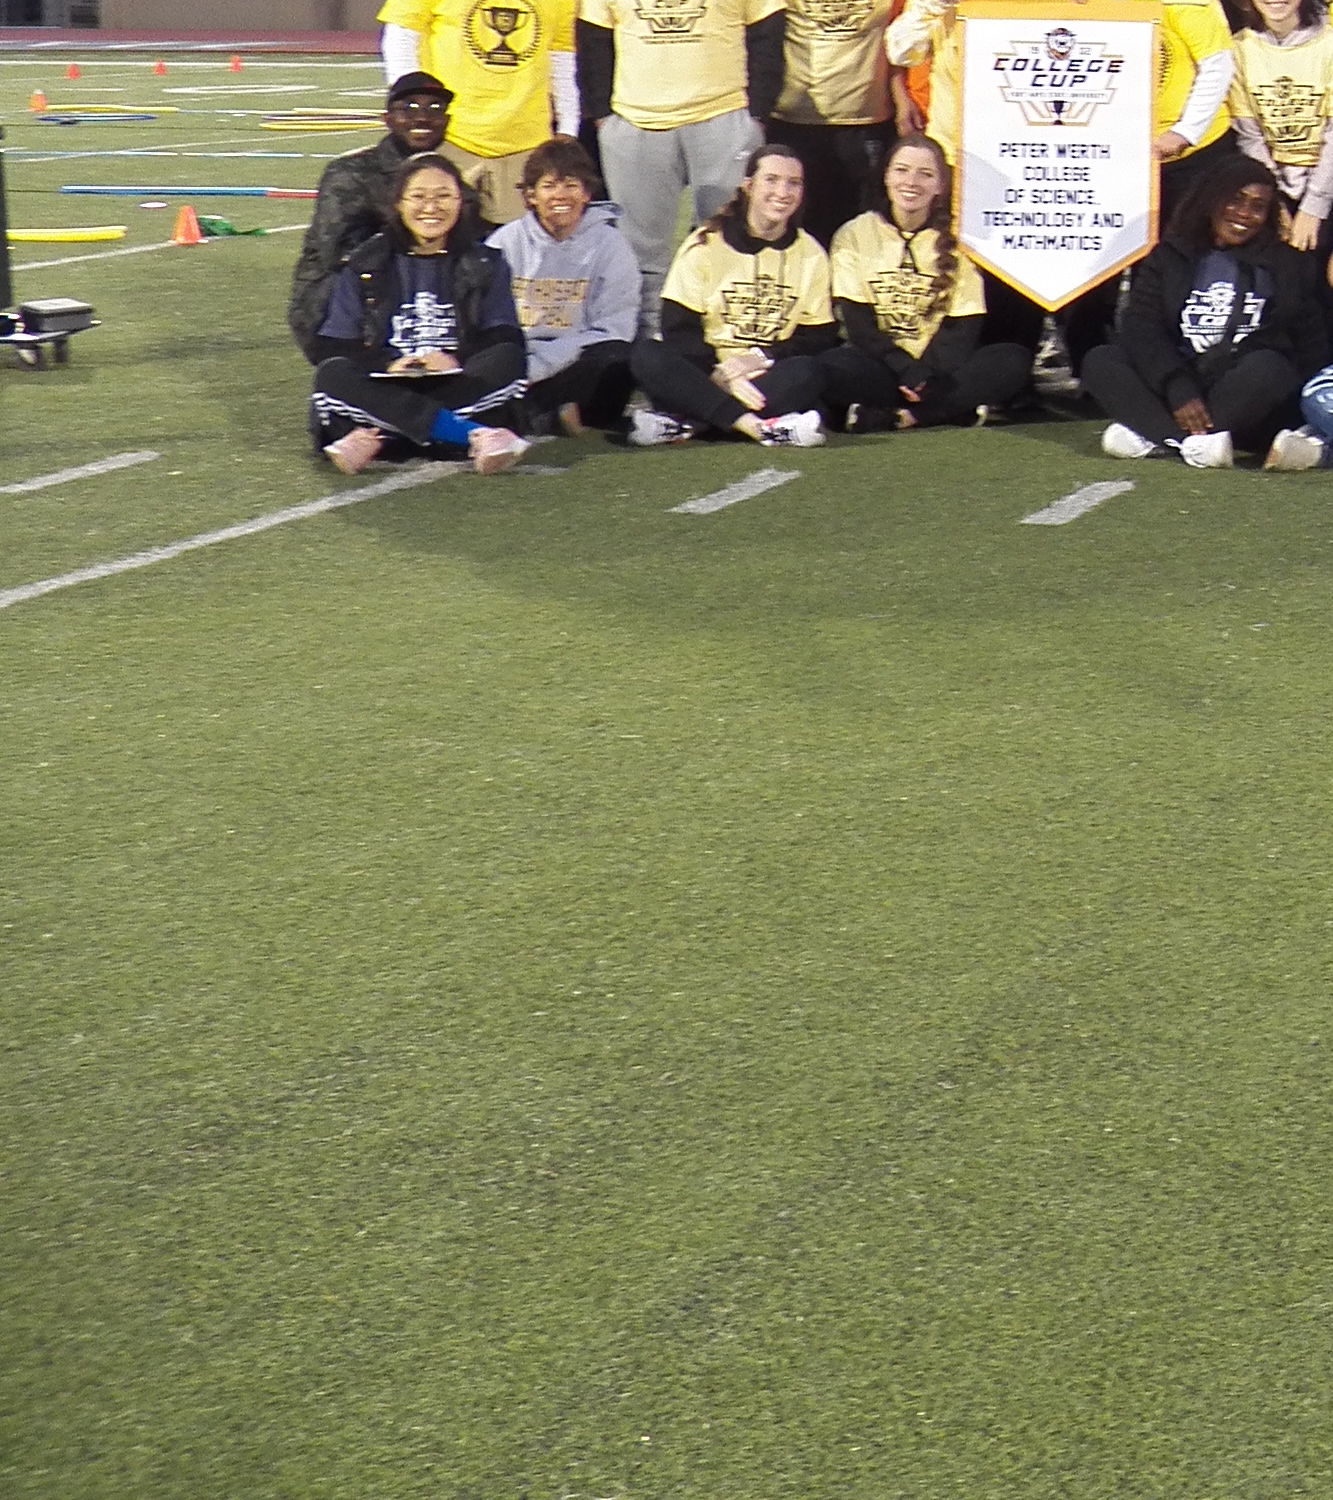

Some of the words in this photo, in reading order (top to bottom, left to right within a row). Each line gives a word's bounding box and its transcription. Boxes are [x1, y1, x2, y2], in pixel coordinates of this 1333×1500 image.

[992, 58, 1125, 73] COLLEGE
[1030, 74, 1087, 88] CUP
[999, 143, 1050, 158] PETER
[1054, 144, 1111, 159] WERTH
[1023, 166, 1091, 181] COLLEGE
[1004, 189, 1026, 204] OF
[982, 211, 1085, 227] TECHNOLOGY
[1091, 213, 1124, 228] AND
